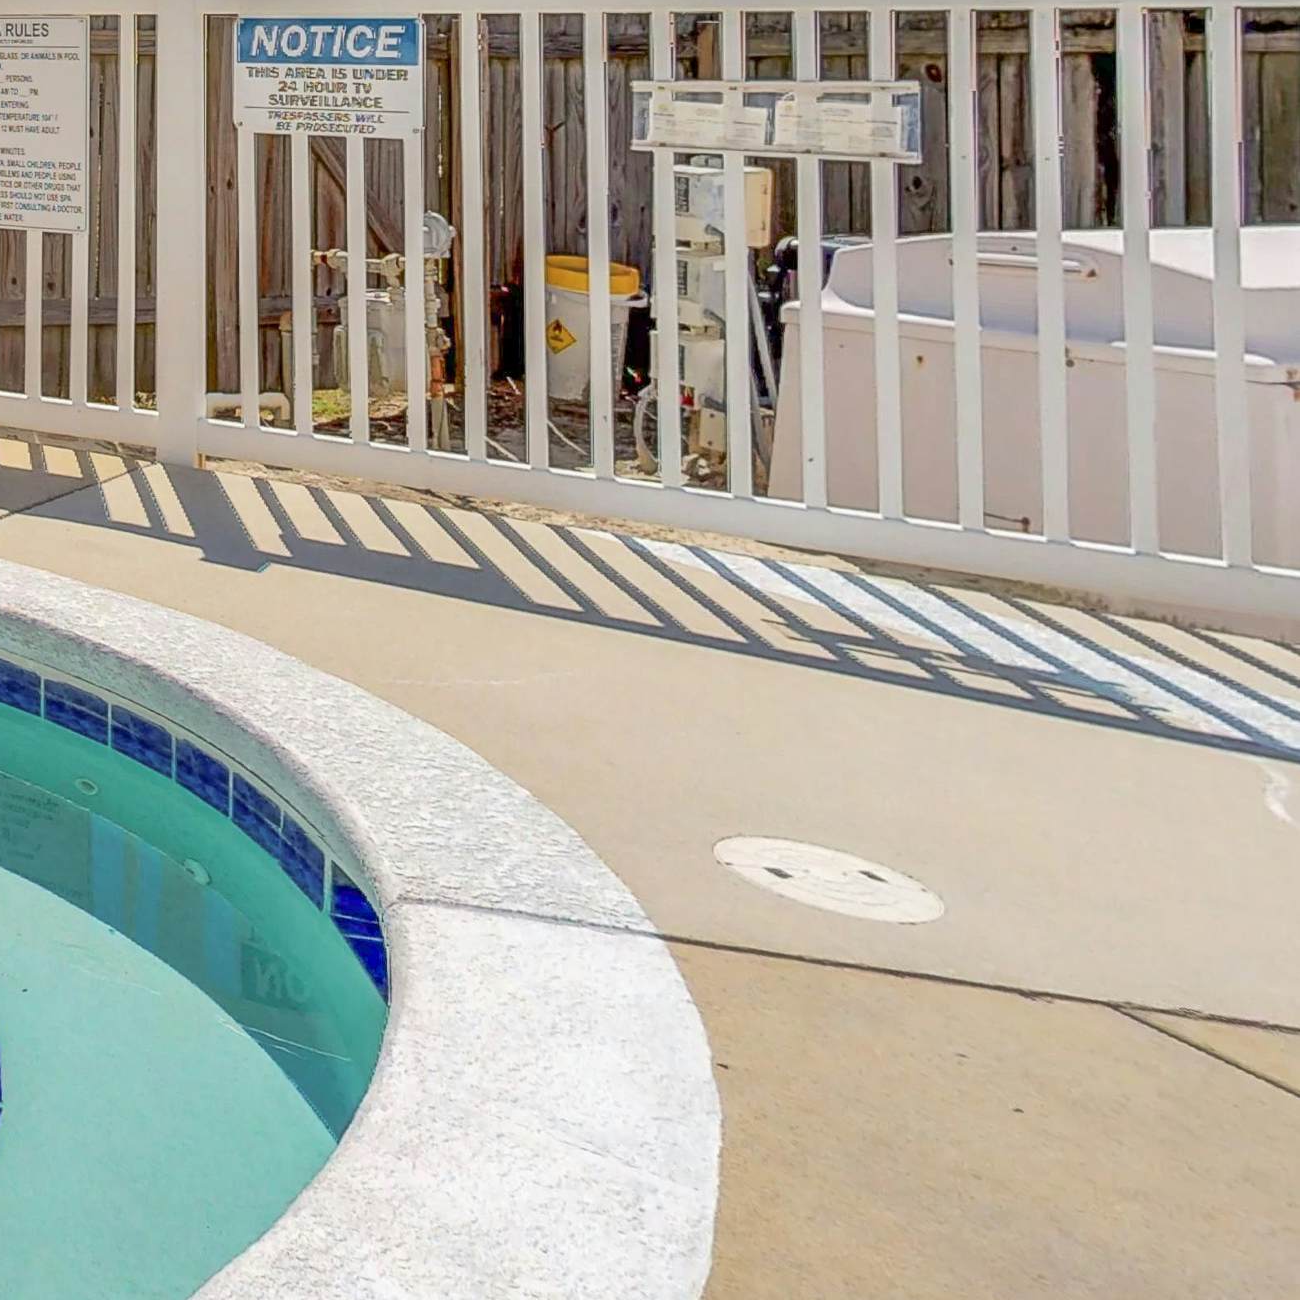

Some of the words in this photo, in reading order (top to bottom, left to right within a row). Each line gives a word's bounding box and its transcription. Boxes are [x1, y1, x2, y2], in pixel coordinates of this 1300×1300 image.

[5, 23, 50, 38] RULES
[252, 25, 406, 59] NOTICE
[30, 53, 56, 61] ANIMALS
[246, 66, 280, 78] THIS
[284, 67, 326, 79] AREA
[331, 68, 348, 80] IS
[352, 68, 409, 81] UNDER
[277, 80, 298, 93] 24
[303, 81, 348, 94] HOUR
[352, 82, 373, 94] TV
[268, 94, 383, 109] SURVEILLANCE
[268, 110, 351, 122] TRESPASSERS
[355, 112, 385, 124] WILL
[41, 126, 60, 134] ADULT
[275, 121, 292, 131] BE
[295, 122, 377, 134] PROSECUTED
[6, 159, 25, 168] SMALL
[58, 161, 82, 171] PEOPLE
[34, 171, 56, 180] PEOPLE
[23, 182, 43, 190] OTHER
[44, 183, 65, 191] DRUGS
[66, 184, 81, 192] THAT
[9, 191, 32, 200] SHOULD
[33, 192, 45, 200] NOT
[46, 193, 58, 202] USE
[15, 202, 51, 212] CONSULTING
